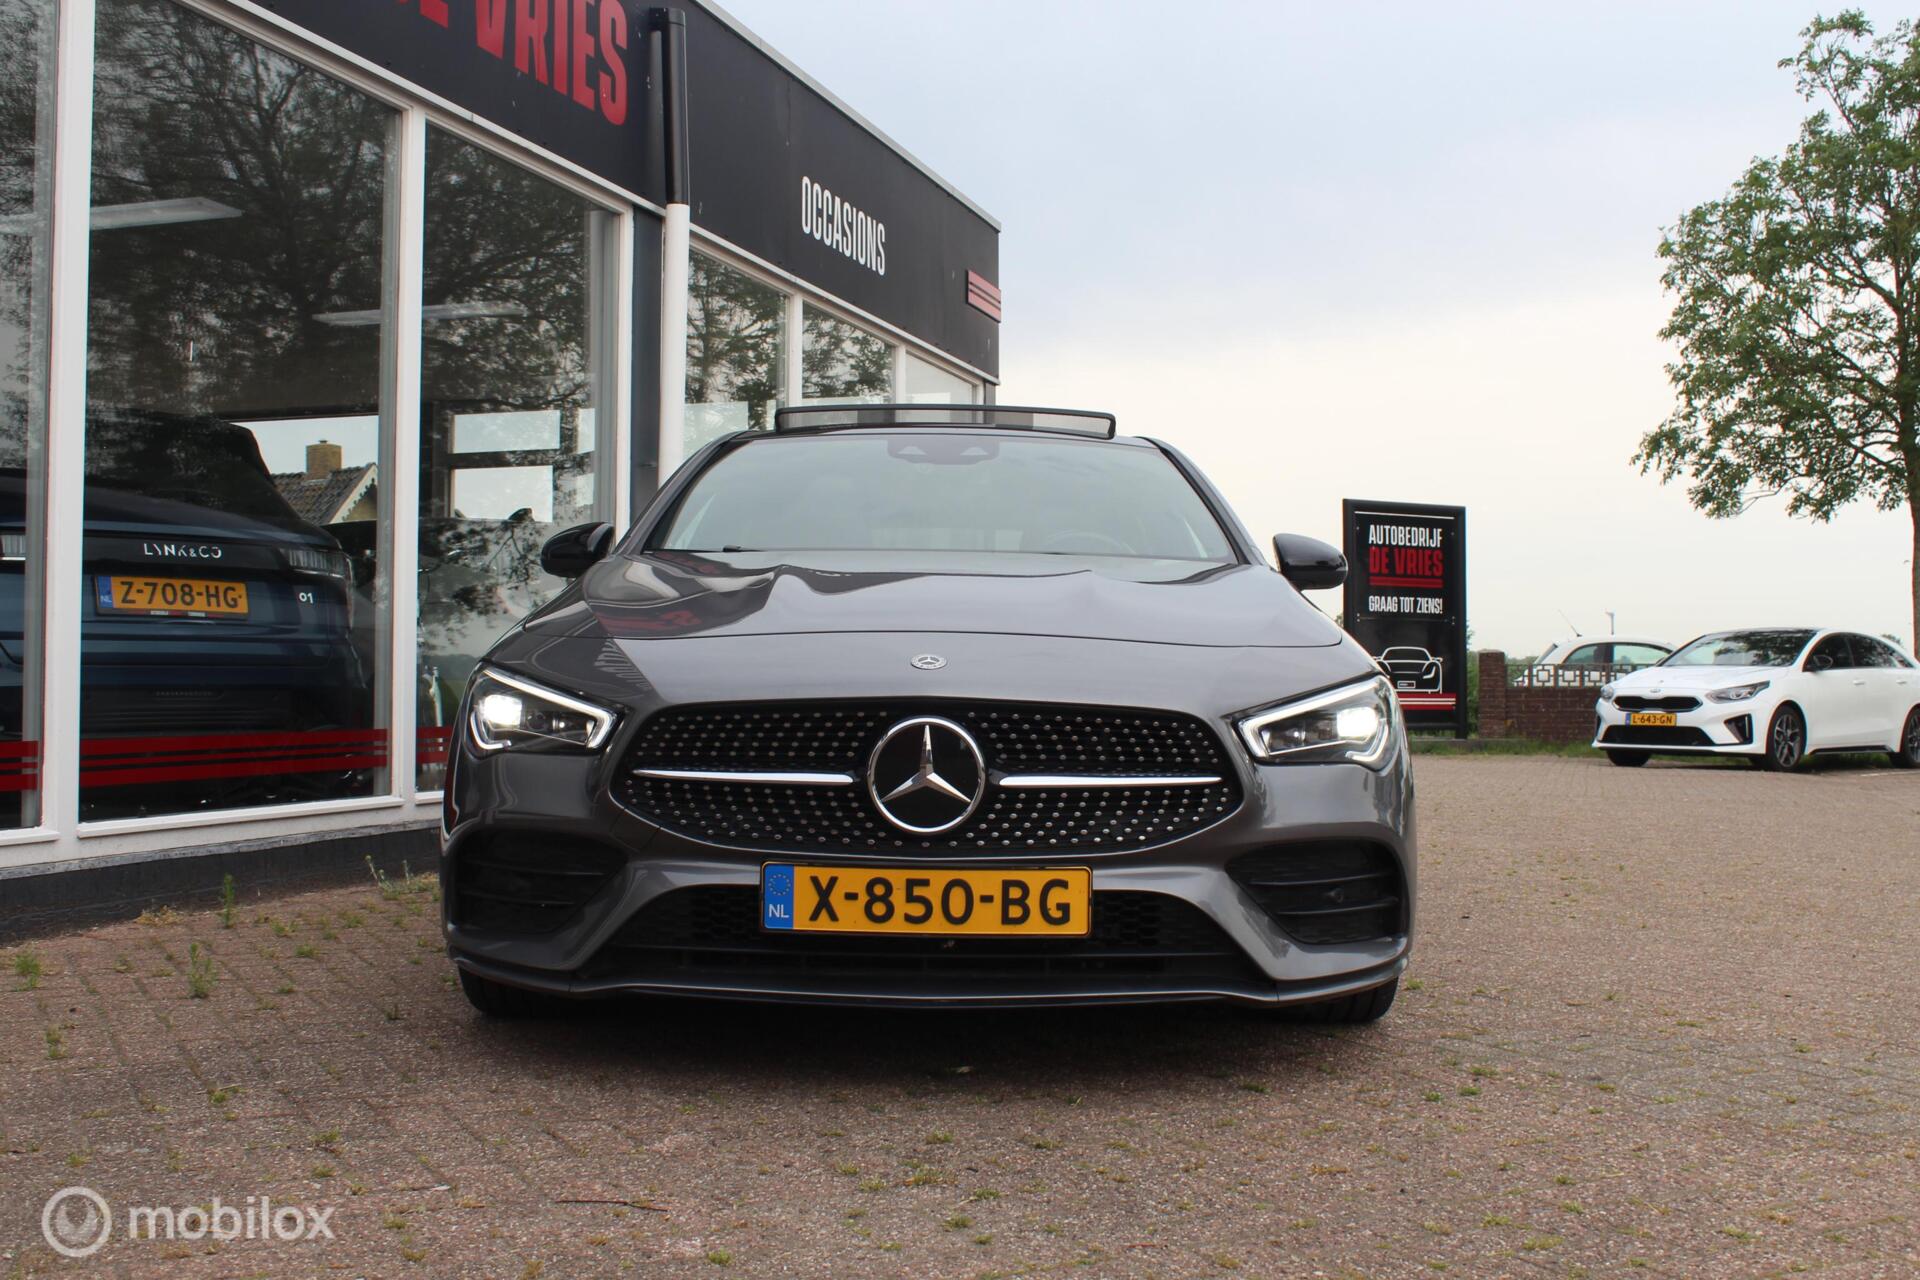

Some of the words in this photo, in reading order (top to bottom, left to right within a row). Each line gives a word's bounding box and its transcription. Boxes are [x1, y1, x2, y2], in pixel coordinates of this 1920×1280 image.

[801, 175, 886, 276] OCCASIONS
[1368, 524, 1443, 547] AUTOBEDRIJF
[1369, 546, 1389, 573] DE
[1394, 549, 1443, 576] VRIES
[1368, 596, 1398, 613] GRAAG
[1400, 597, 1415, 613] TOT
[1416, 597, 1443, 615] ZIENS!
[1632, 715, 1673, 724] L-643-GN
[768, 904, 789, 919] NL
[808, 875, 1072, 926] X-850-BG
